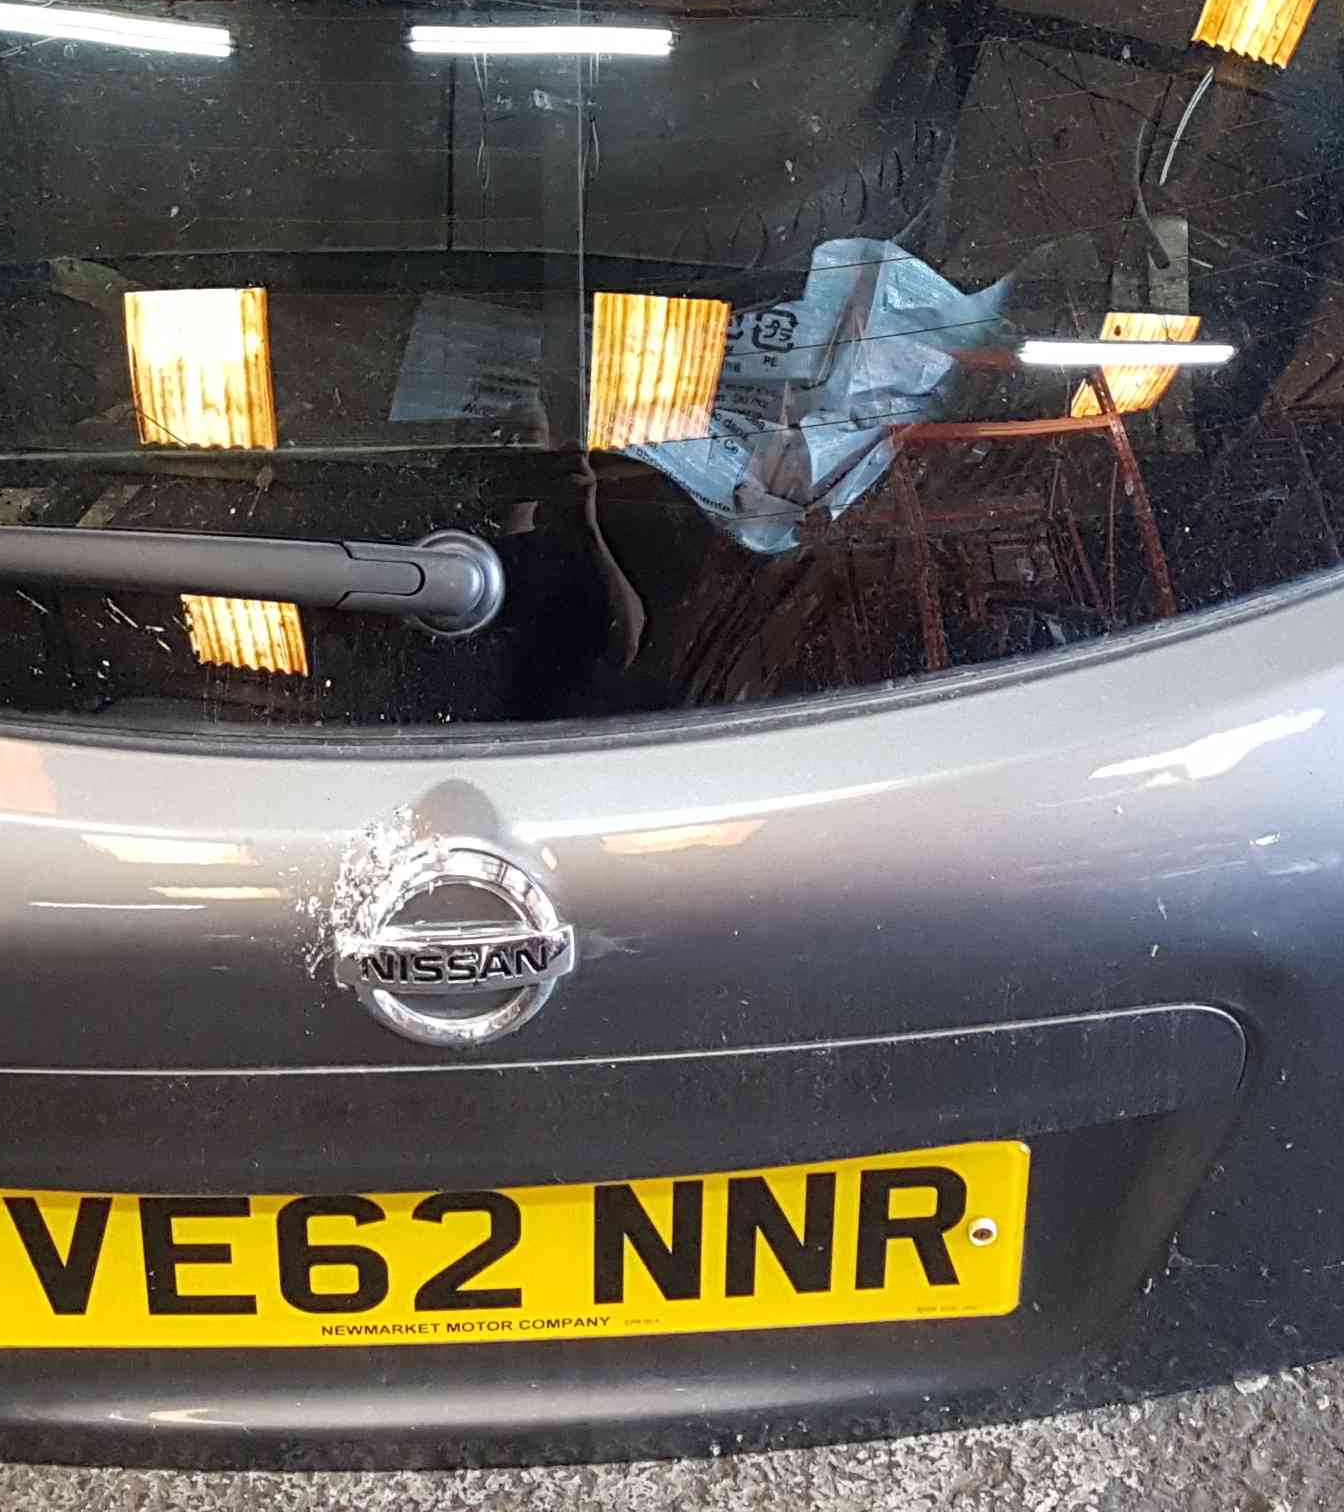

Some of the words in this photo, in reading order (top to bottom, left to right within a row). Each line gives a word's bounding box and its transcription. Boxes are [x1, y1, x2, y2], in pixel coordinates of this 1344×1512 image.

[359, 945, 550, 983] NISSAN
[2, 1190, 522, 1316] VE62
[594, 1166, 968, 1305] NNR
[321, 1322, 441, 1337] NEWMARKET
[446, 1320, 513, 1334] MOTOR
[518, 1316, 611, 1331] COMPANY
